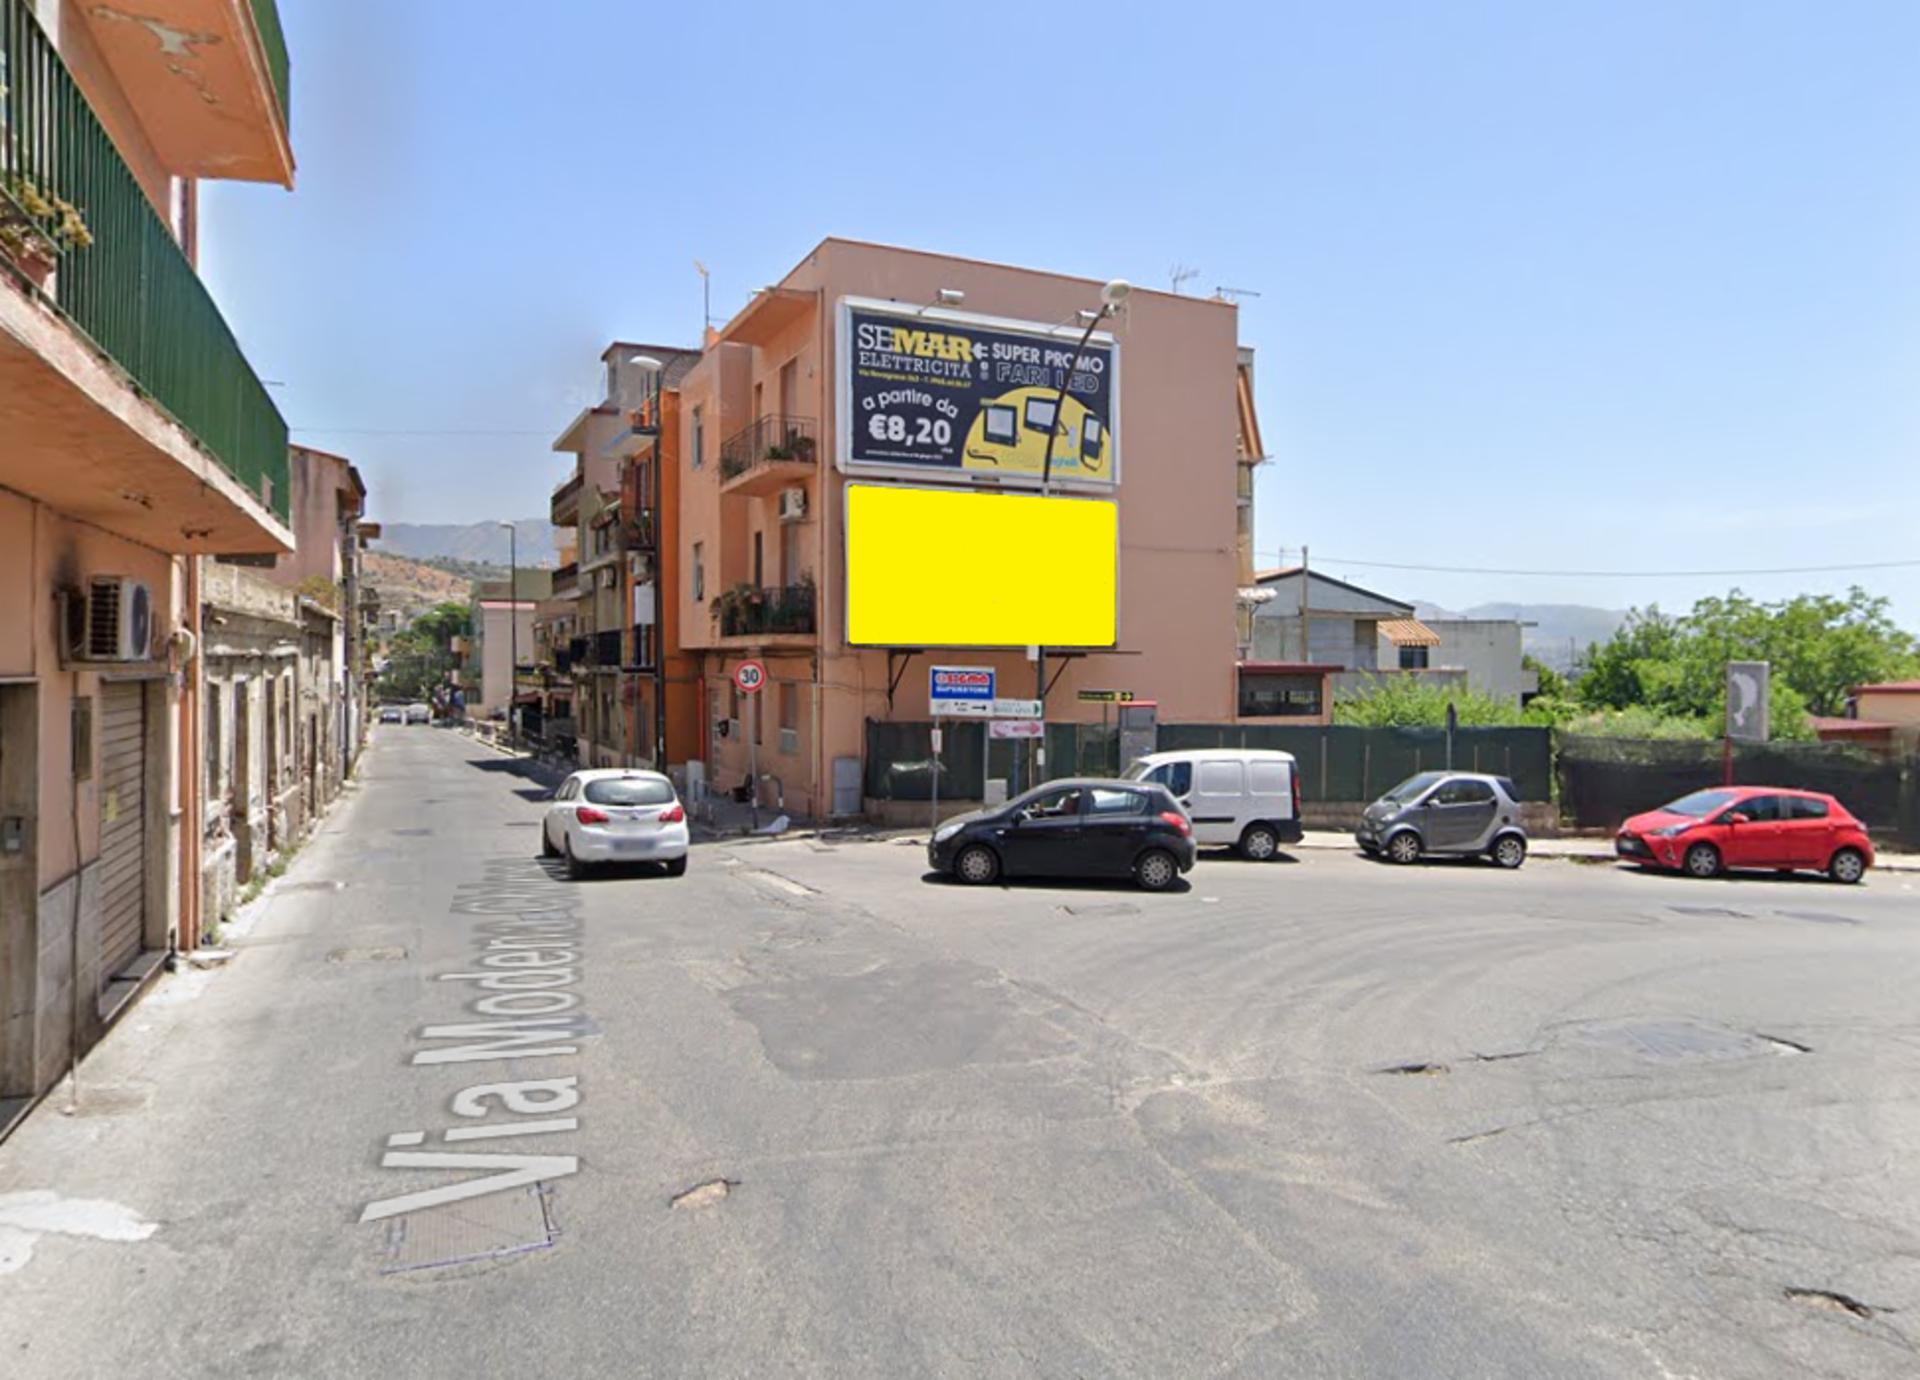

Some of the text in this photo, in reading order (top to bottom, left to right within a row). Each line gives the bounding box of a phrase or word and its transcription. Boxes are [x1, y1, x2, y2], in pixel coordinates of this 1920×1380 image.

[858, 323, 972, 362] SEMAR
[992, 342, 1104, 373] SUPER PROMO
[996, 361, 1050, 386] FARI
[862, 388, 959, 419] a partire da
[868, 413, 952, 446] €8,20
[742, 669, 759, 684] 30
